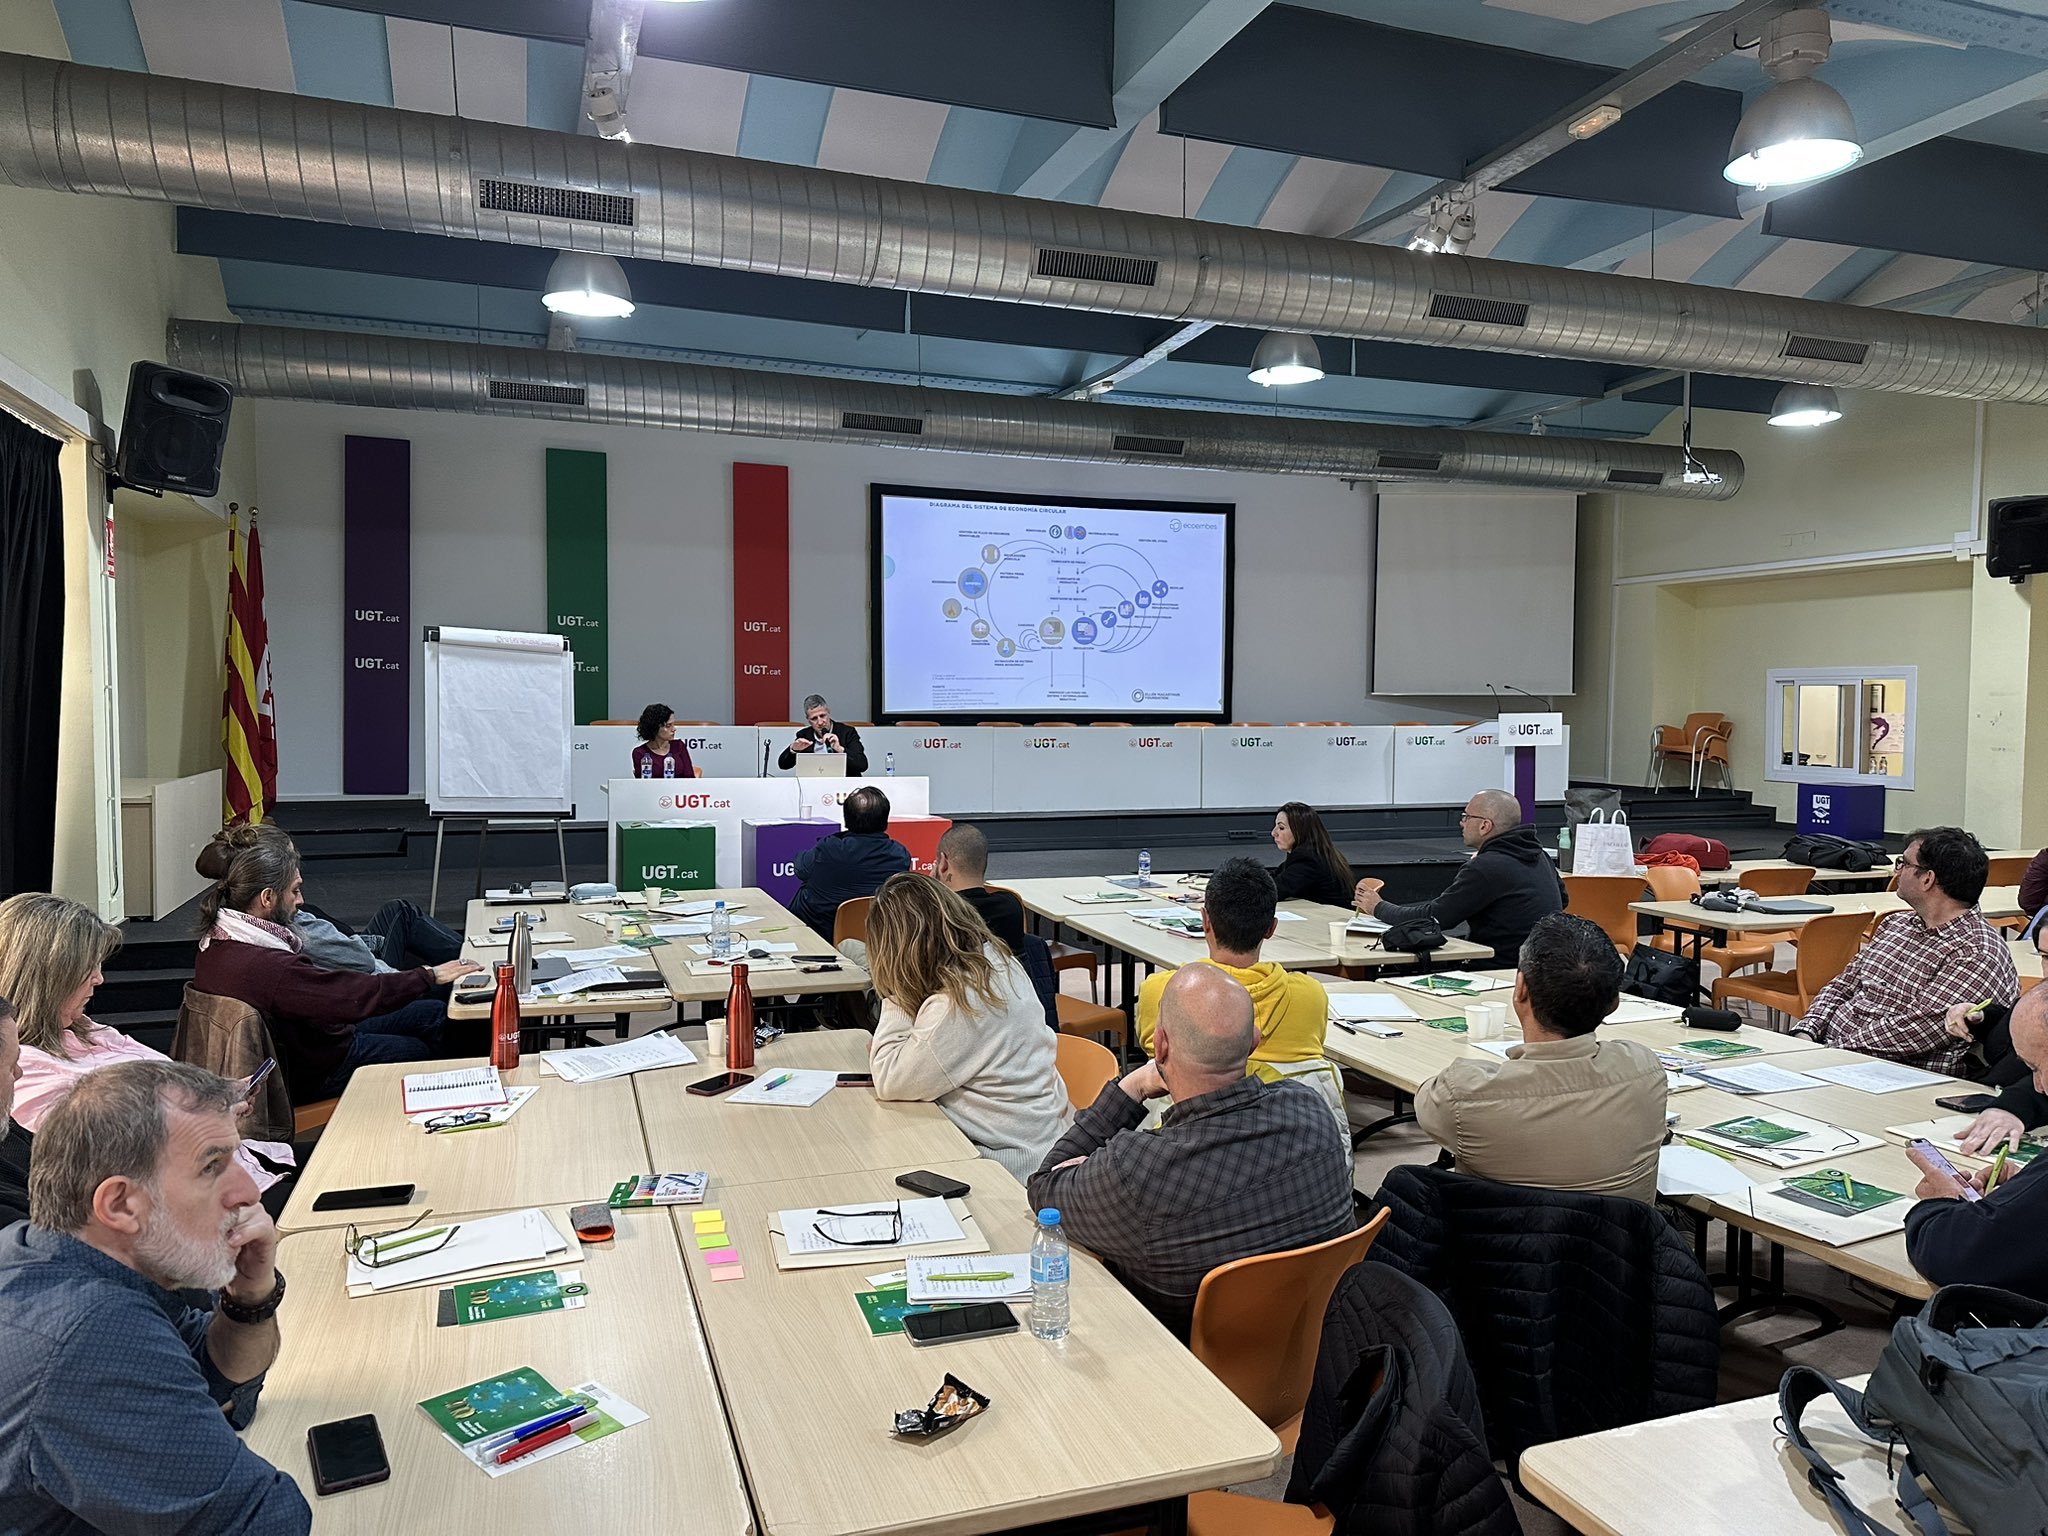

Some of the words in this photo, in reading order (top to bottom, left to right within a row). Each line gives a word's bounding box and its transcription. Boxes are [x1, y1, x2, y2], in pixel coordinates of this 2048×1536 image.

[354, 609, 400, 623] UGT.cat
[557, 615, 599, 627] UGT.cat
[743, 621, 781, 633] UGT.cat
[354, 657, 400, 670] UGT.cat
[573, 661, 599, 673] T.cat
[743, 664, 781, 676] UGT.cat
[1518, 724, 1554, 735] UGT.cat
[924, 738, 961, 749] UGT.cat
[1033, 738, 1070, 748] UGT.cat
[1138, 738, 1173, 748] UGT.cat
[1240, 737, 1273, 748] UGT.cat
[1336, 736, 1367, 746] UGT.cat
[1415, 736, 1446, 746] UGT.cat
[674, 794, 731, 809] UGT.cat
[1816, 796, 1830, 805] UGT
[642, 865, 699, 880] UGT.cat
